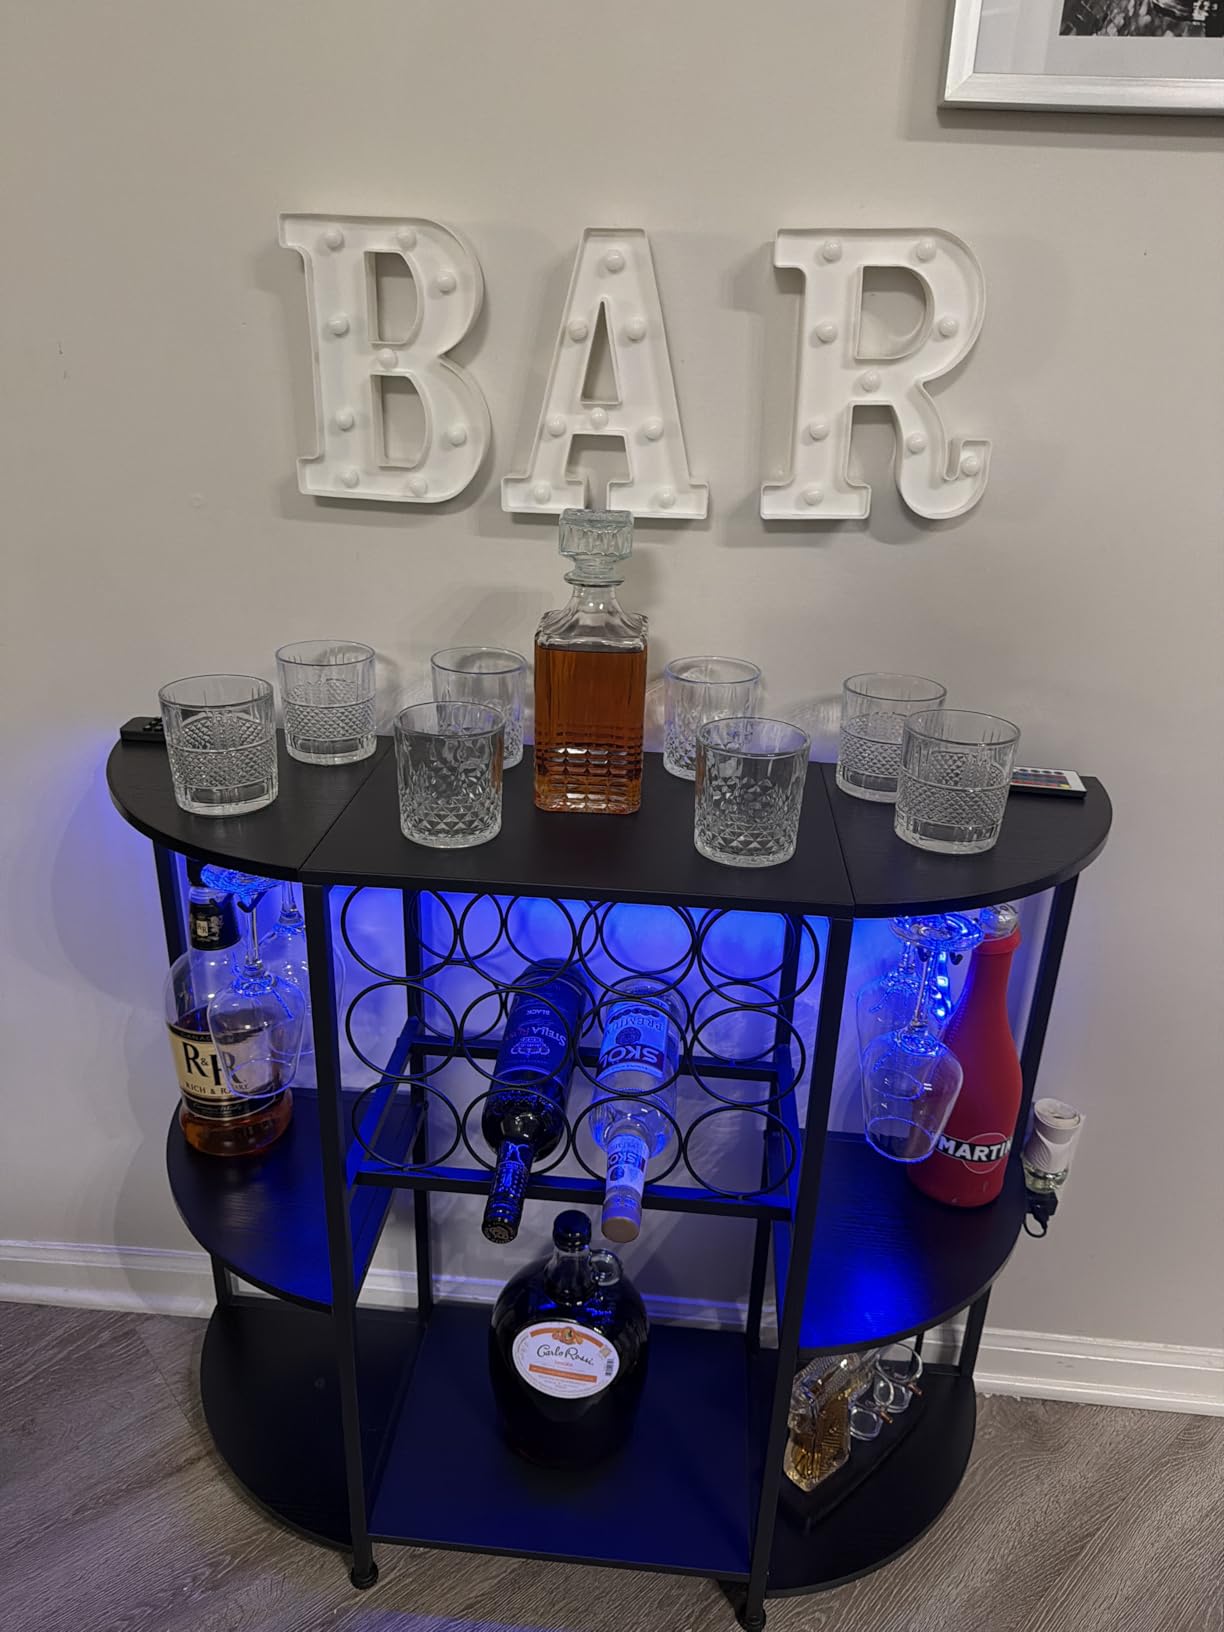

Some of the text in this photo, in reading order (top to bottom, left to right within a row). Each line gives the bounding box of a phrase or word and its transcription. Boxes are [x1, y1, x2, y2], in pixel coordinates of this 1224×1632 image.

[279, 213, 993, 520] BAR
[184, 1081, 206, 1094] RICH
[938, 1135, 1013, 1161] MARTIN
[536, 1343, 564, 1358] Carlo
[564, 1346, 595, 1366] Rossi
